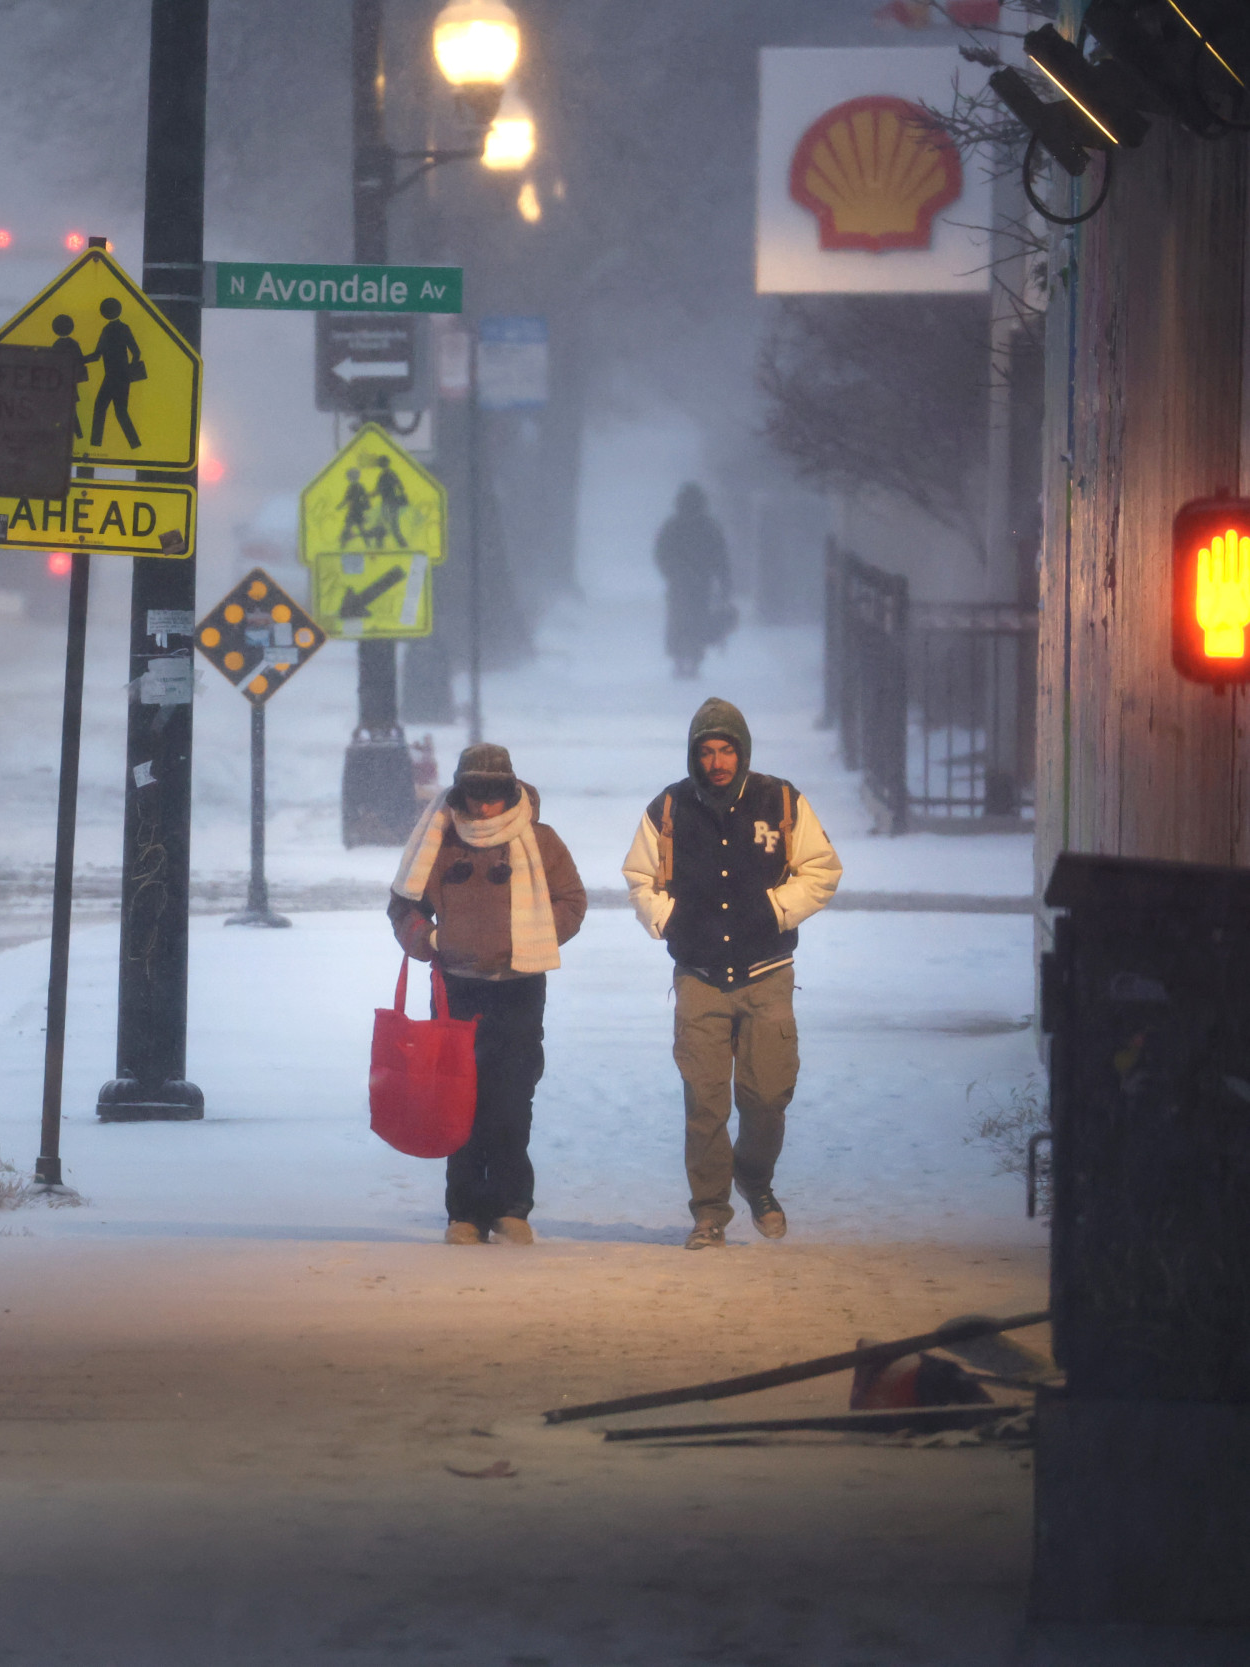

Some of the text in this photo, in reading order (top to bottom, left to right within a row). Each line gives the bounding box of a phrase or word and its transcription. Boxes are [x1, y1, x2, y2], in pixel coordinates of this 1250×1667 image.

[231, 271, 447, 304] N Avondale Av
[8, 497, 157, 537] AHEAD
